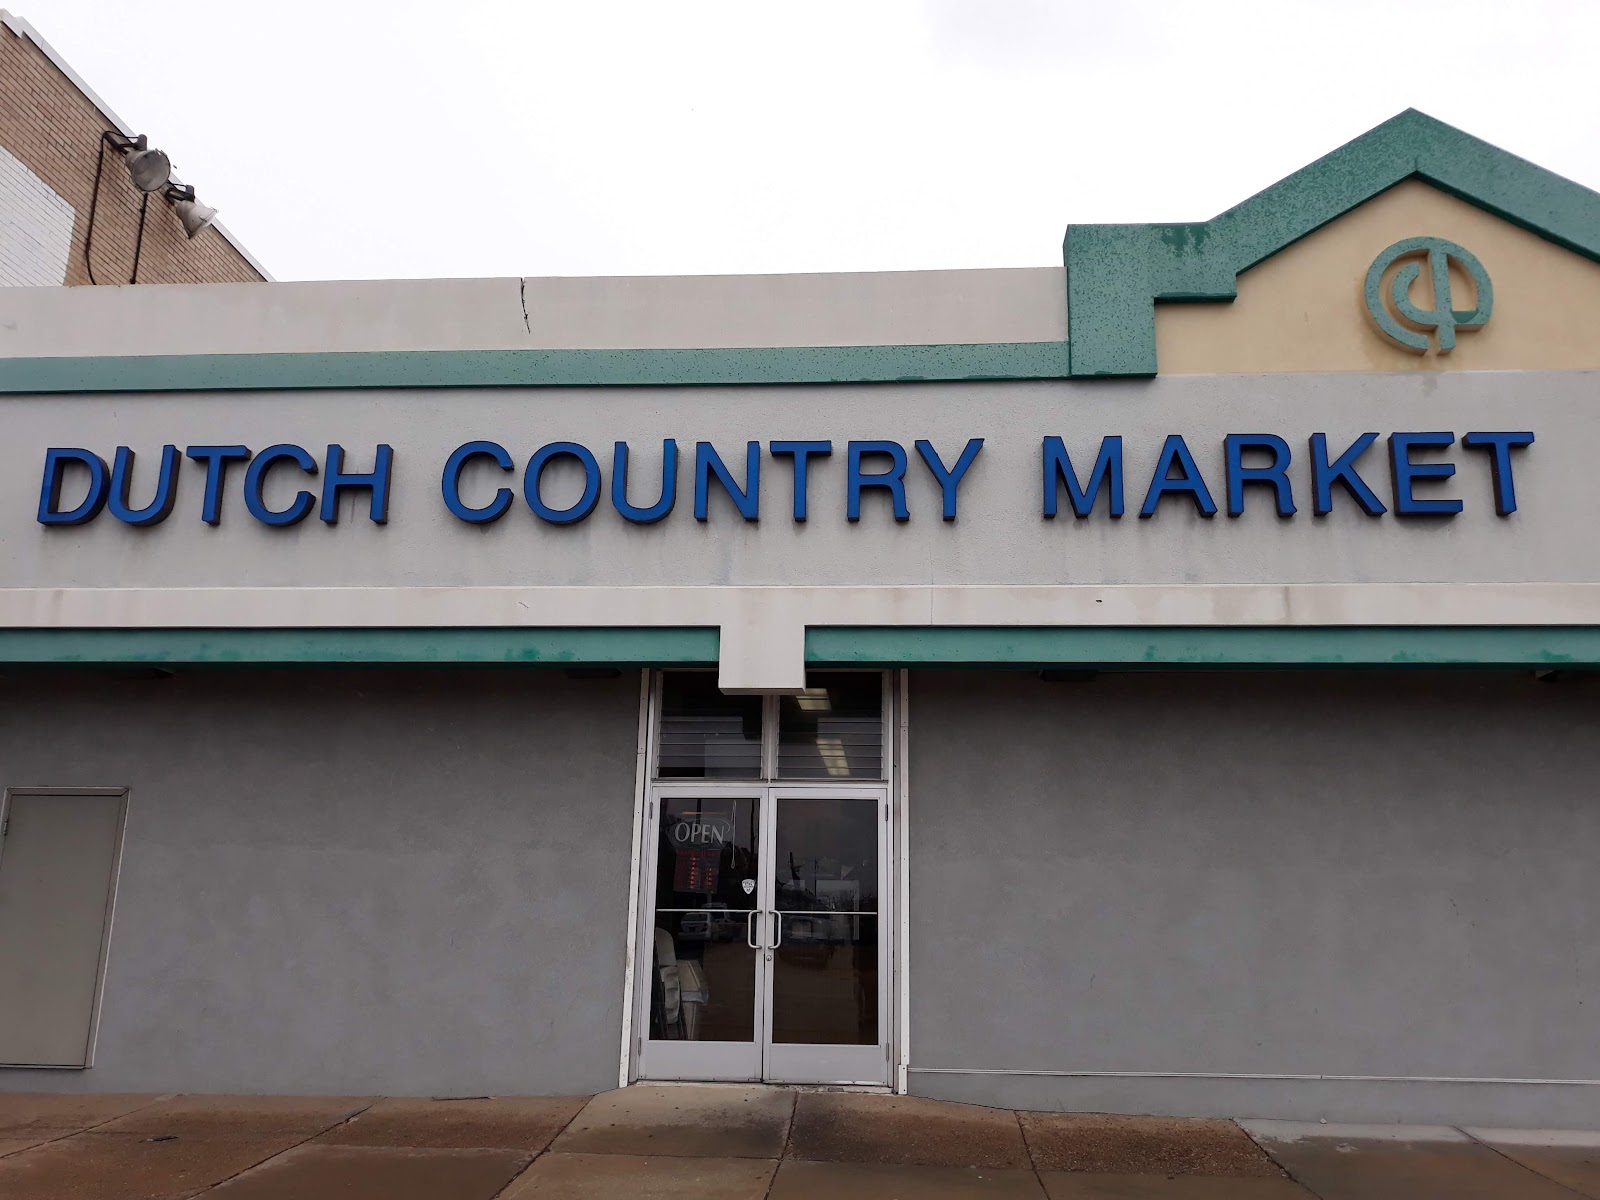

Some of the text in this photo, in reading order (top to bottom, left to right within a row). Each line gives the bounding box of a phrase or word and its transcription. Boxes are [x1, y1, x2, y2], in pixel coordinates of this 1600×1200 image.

[37, 431, 1535, 527] DUTCH COUNTRY MARKET
[675, 822, 724, 844] OPEN
